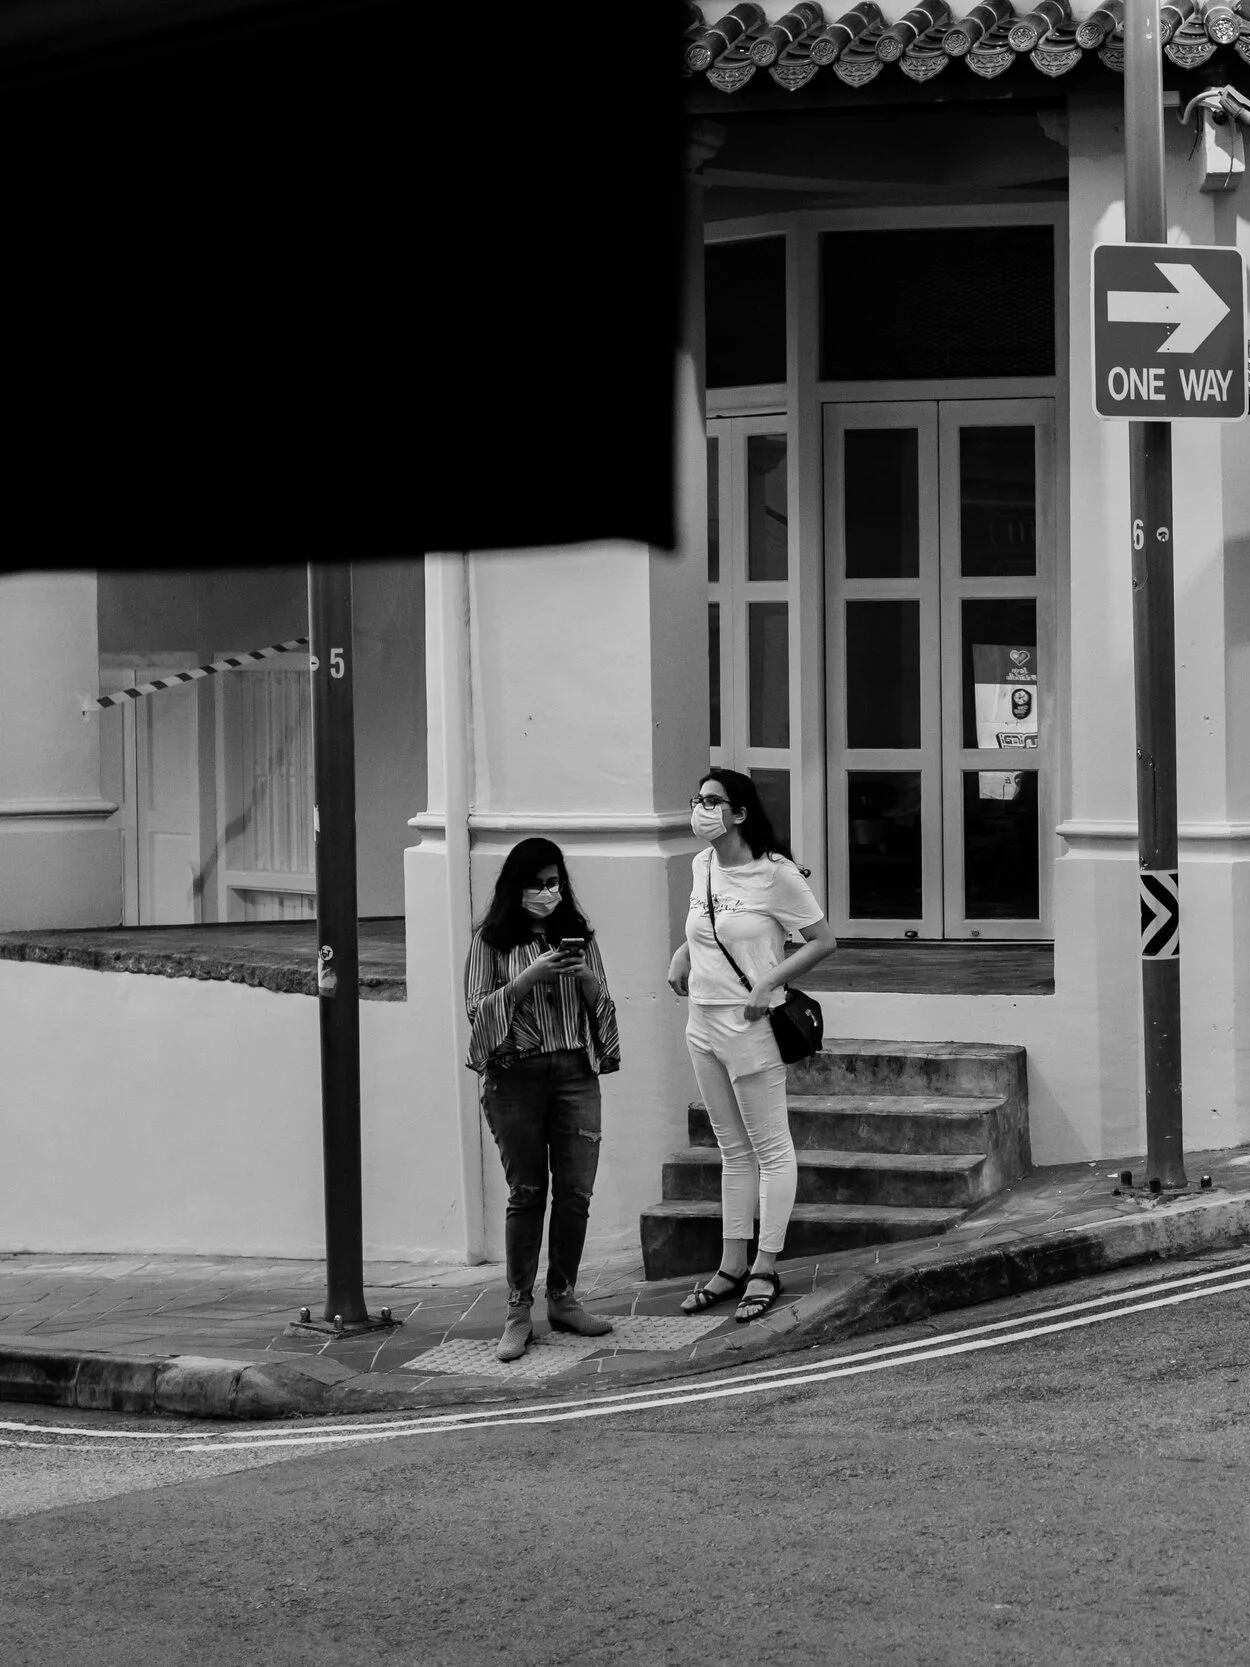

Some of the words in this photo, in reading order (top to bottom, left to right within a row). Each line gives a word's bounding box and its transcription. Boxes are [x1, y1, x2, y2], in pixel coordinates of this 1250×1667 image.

[1107, 366, 1166, 401] ONE
[1179, 368, 1233, 402] WAY
[1133, 518, 1144, 550] 6
[330, 647, 345, 679] 5
